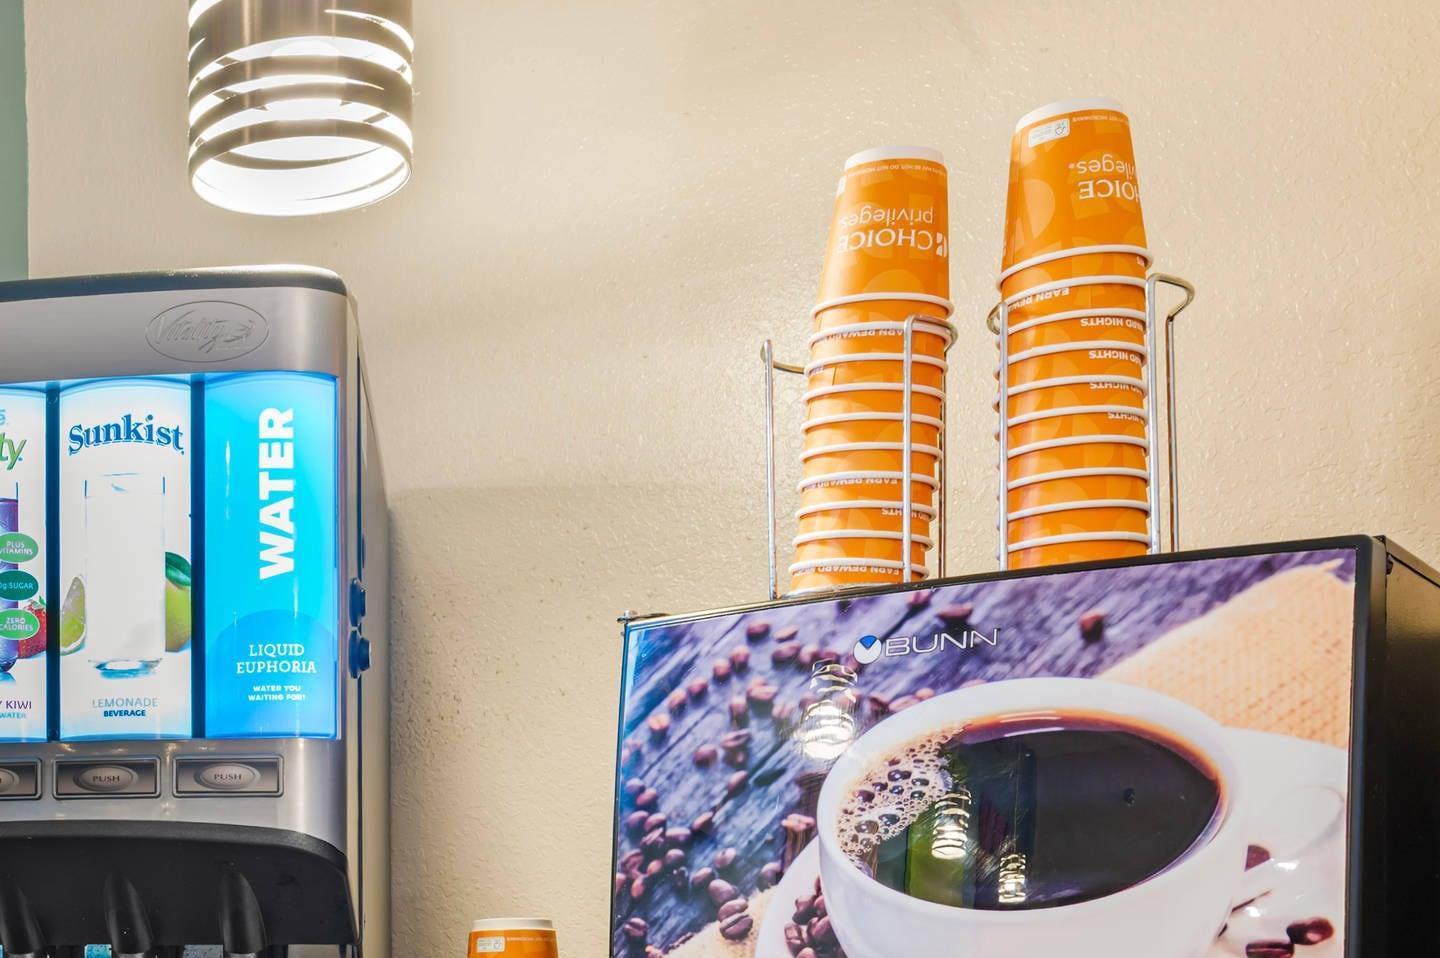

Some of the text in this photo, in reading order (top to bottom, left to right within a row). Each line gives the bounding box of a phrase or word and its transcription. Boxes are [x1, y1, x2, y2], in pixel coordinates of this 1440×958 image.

[838, 205, 934, 231] privileges
[838, 228, 933, 254] CHOICE
[1080, 318, 1124, 327] NIGHTS
[1088, 350, 1129, 361] NIGHTS
[67, 410, 183, 456] Sunkist
[259, 407, 295, 580] WATER
[6, 541, 25, 549] PLUS
[885, 628, 998, 657] BUNN
[249, 643, 305, 657] LIQUID
[236, 660, 317, 674] EUPHORIA
[92, 697, 158, 709] LEMONADE
[248, 694, 284, 702] WAITING
[6, 700, 32, 711] KIWI
[103, 709, 146, 718] BEVERAGE
[92, 775, 120, 783] PUSH
[213, 773, 242, 781] PUSH
